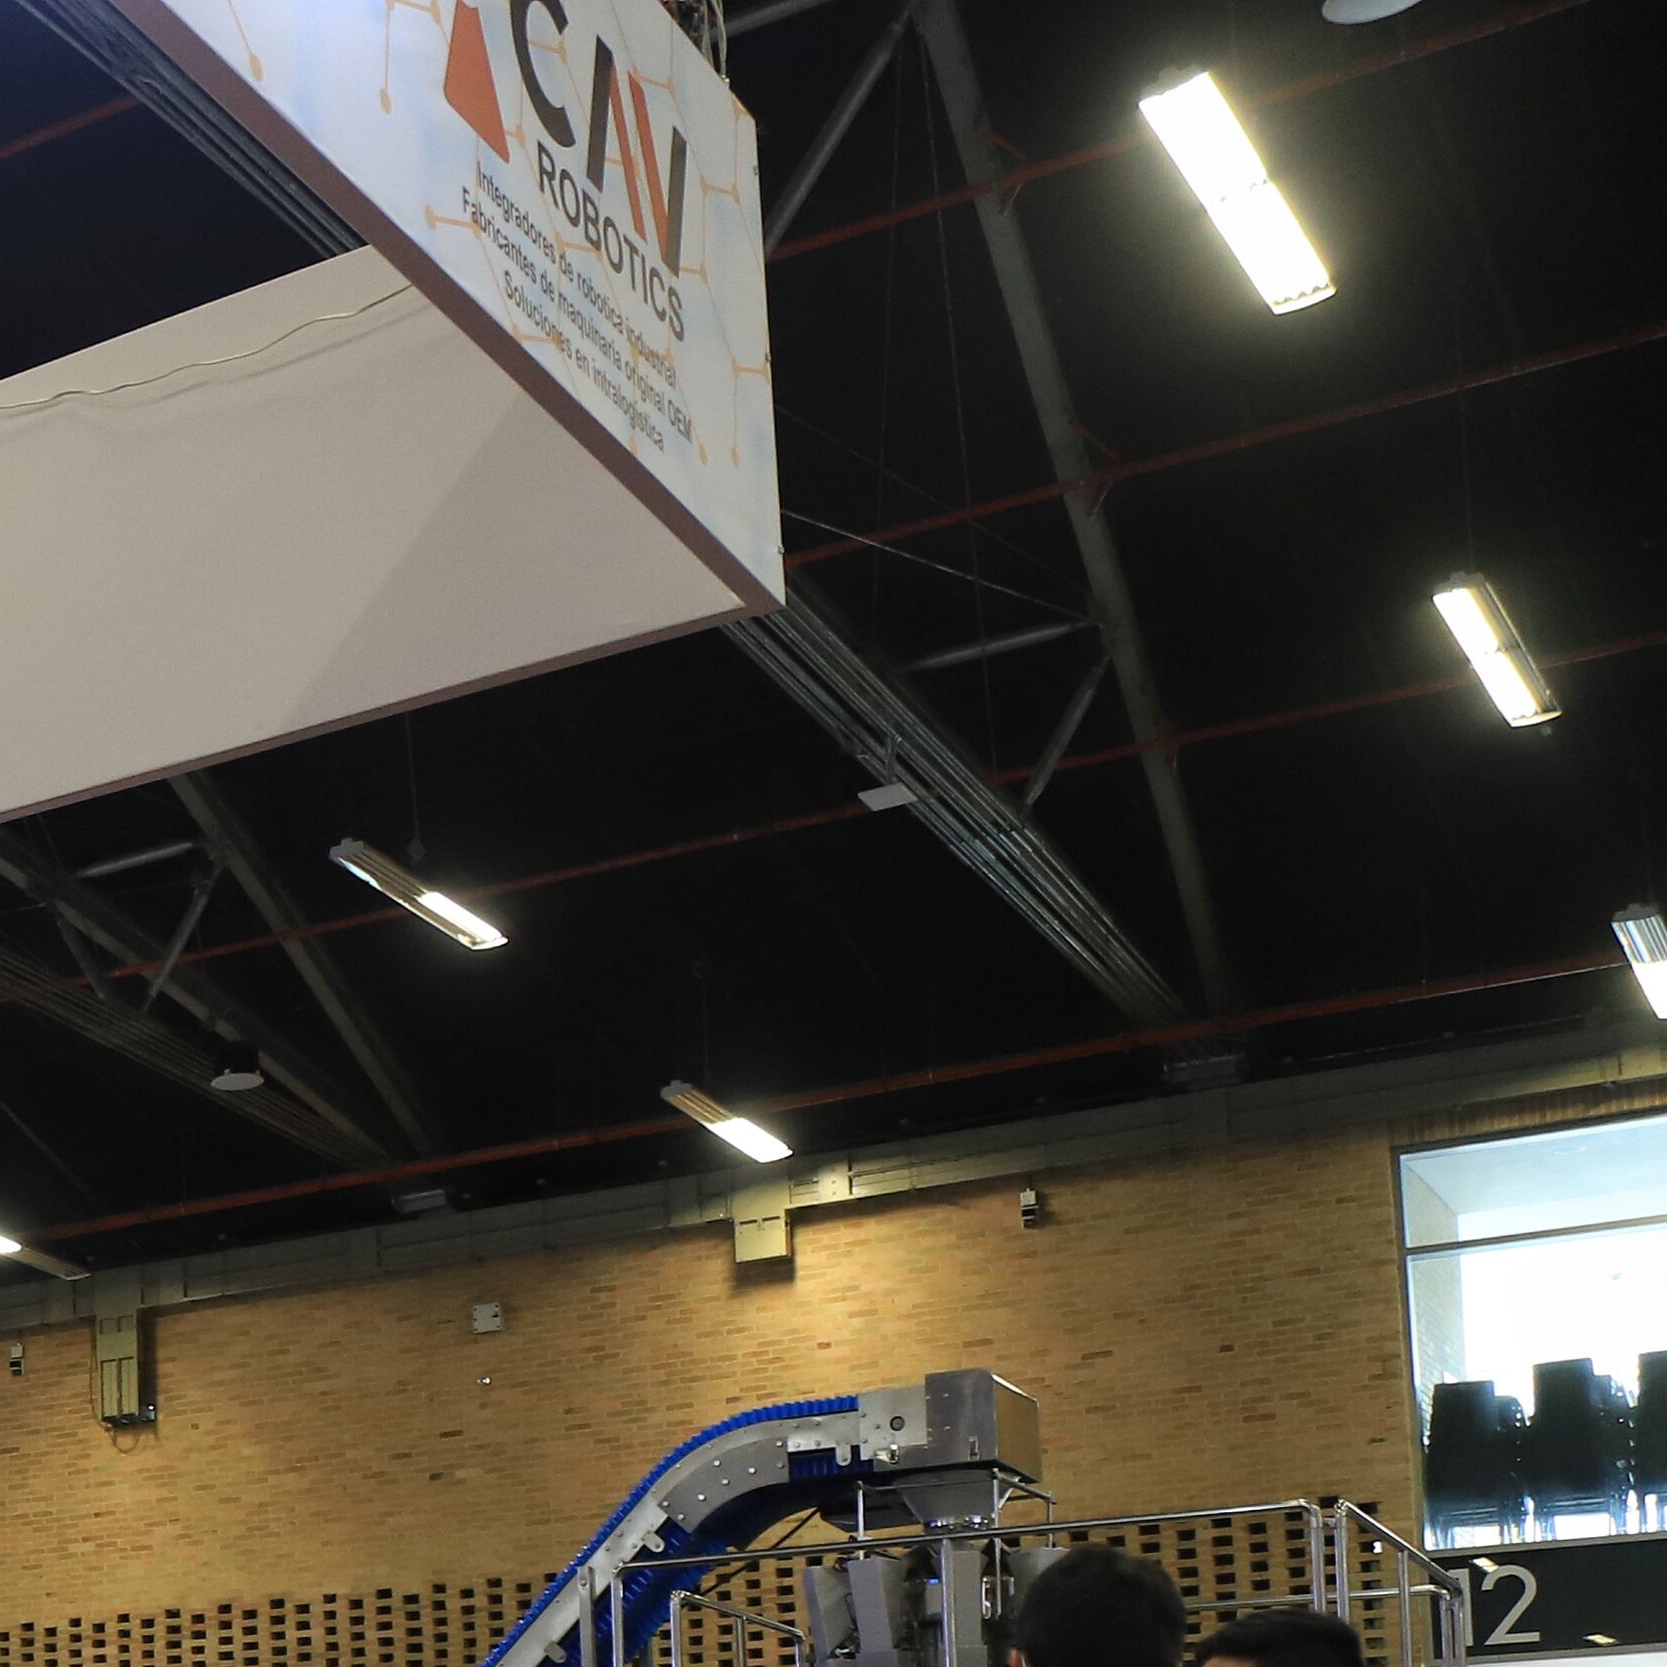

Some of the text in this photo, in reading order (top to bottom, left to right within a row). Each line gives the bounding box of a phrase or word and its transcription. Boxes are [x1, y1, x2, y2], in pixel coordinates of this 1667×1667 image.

[510, 0, 687, 278] CAV
[462, 186, 538, 284] Fabricantes
[540, 269, 555, 302] de
[476, 161, 557, 264] Integradores
[559, 252, 574, 283] de
[537, 141, 685, 341] ROBOTICS
[504, 269, 573, 360] Soluciones
